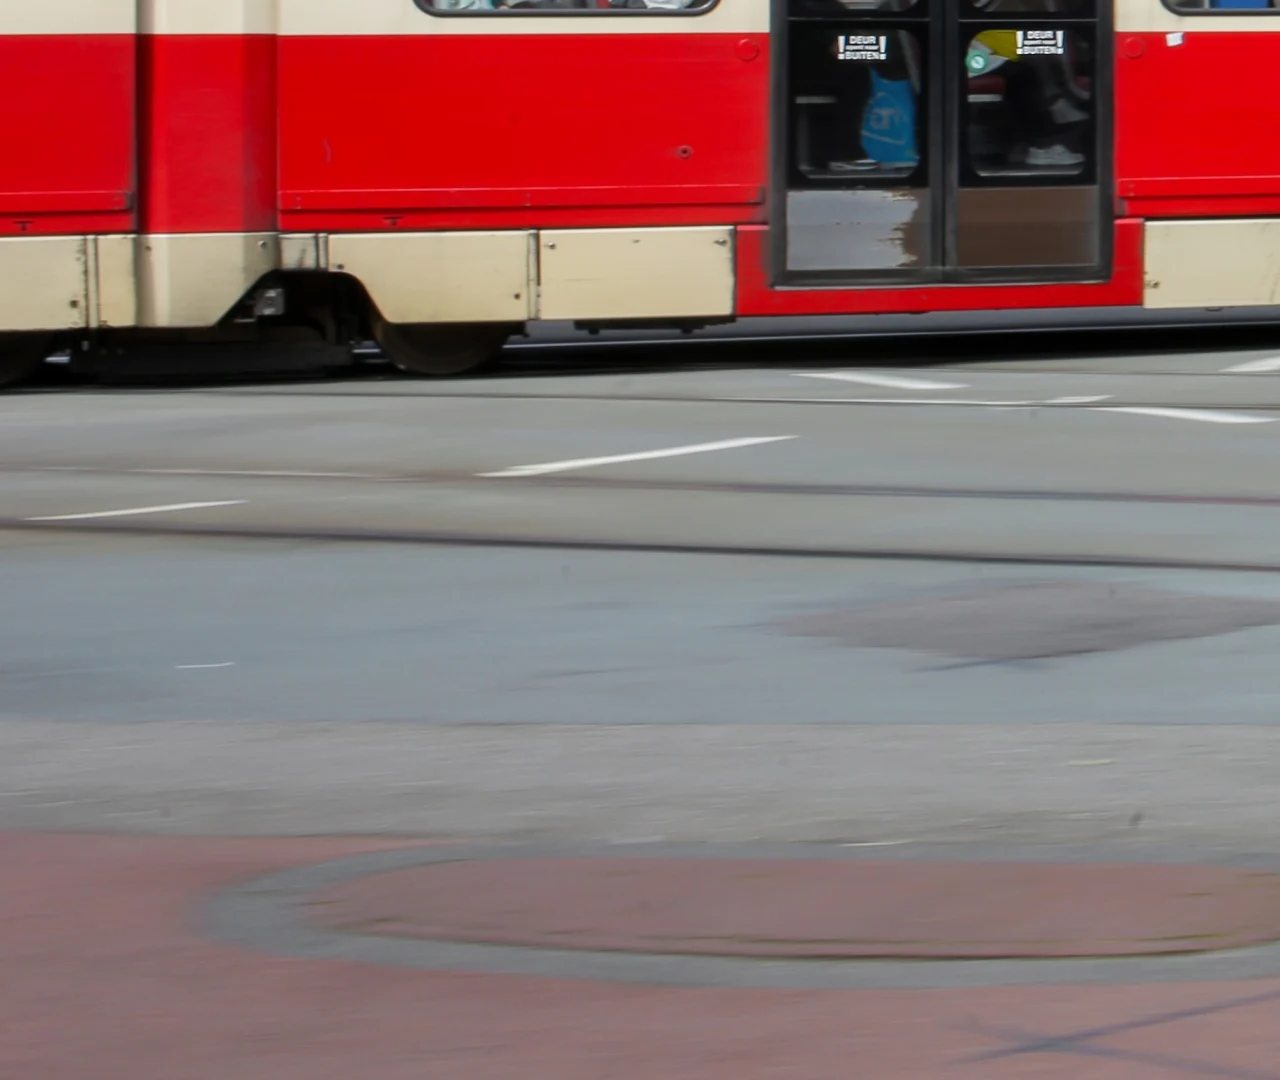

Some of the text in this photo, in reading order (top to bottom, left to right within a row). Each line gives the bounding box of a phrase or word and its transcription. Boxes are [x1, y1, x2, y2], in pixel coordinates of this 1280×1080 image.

[1027, 31, 1054, 39] DEUR
[849, 36, 876, 44] DEUR
[845, 51, 879, 59] BUITEN
